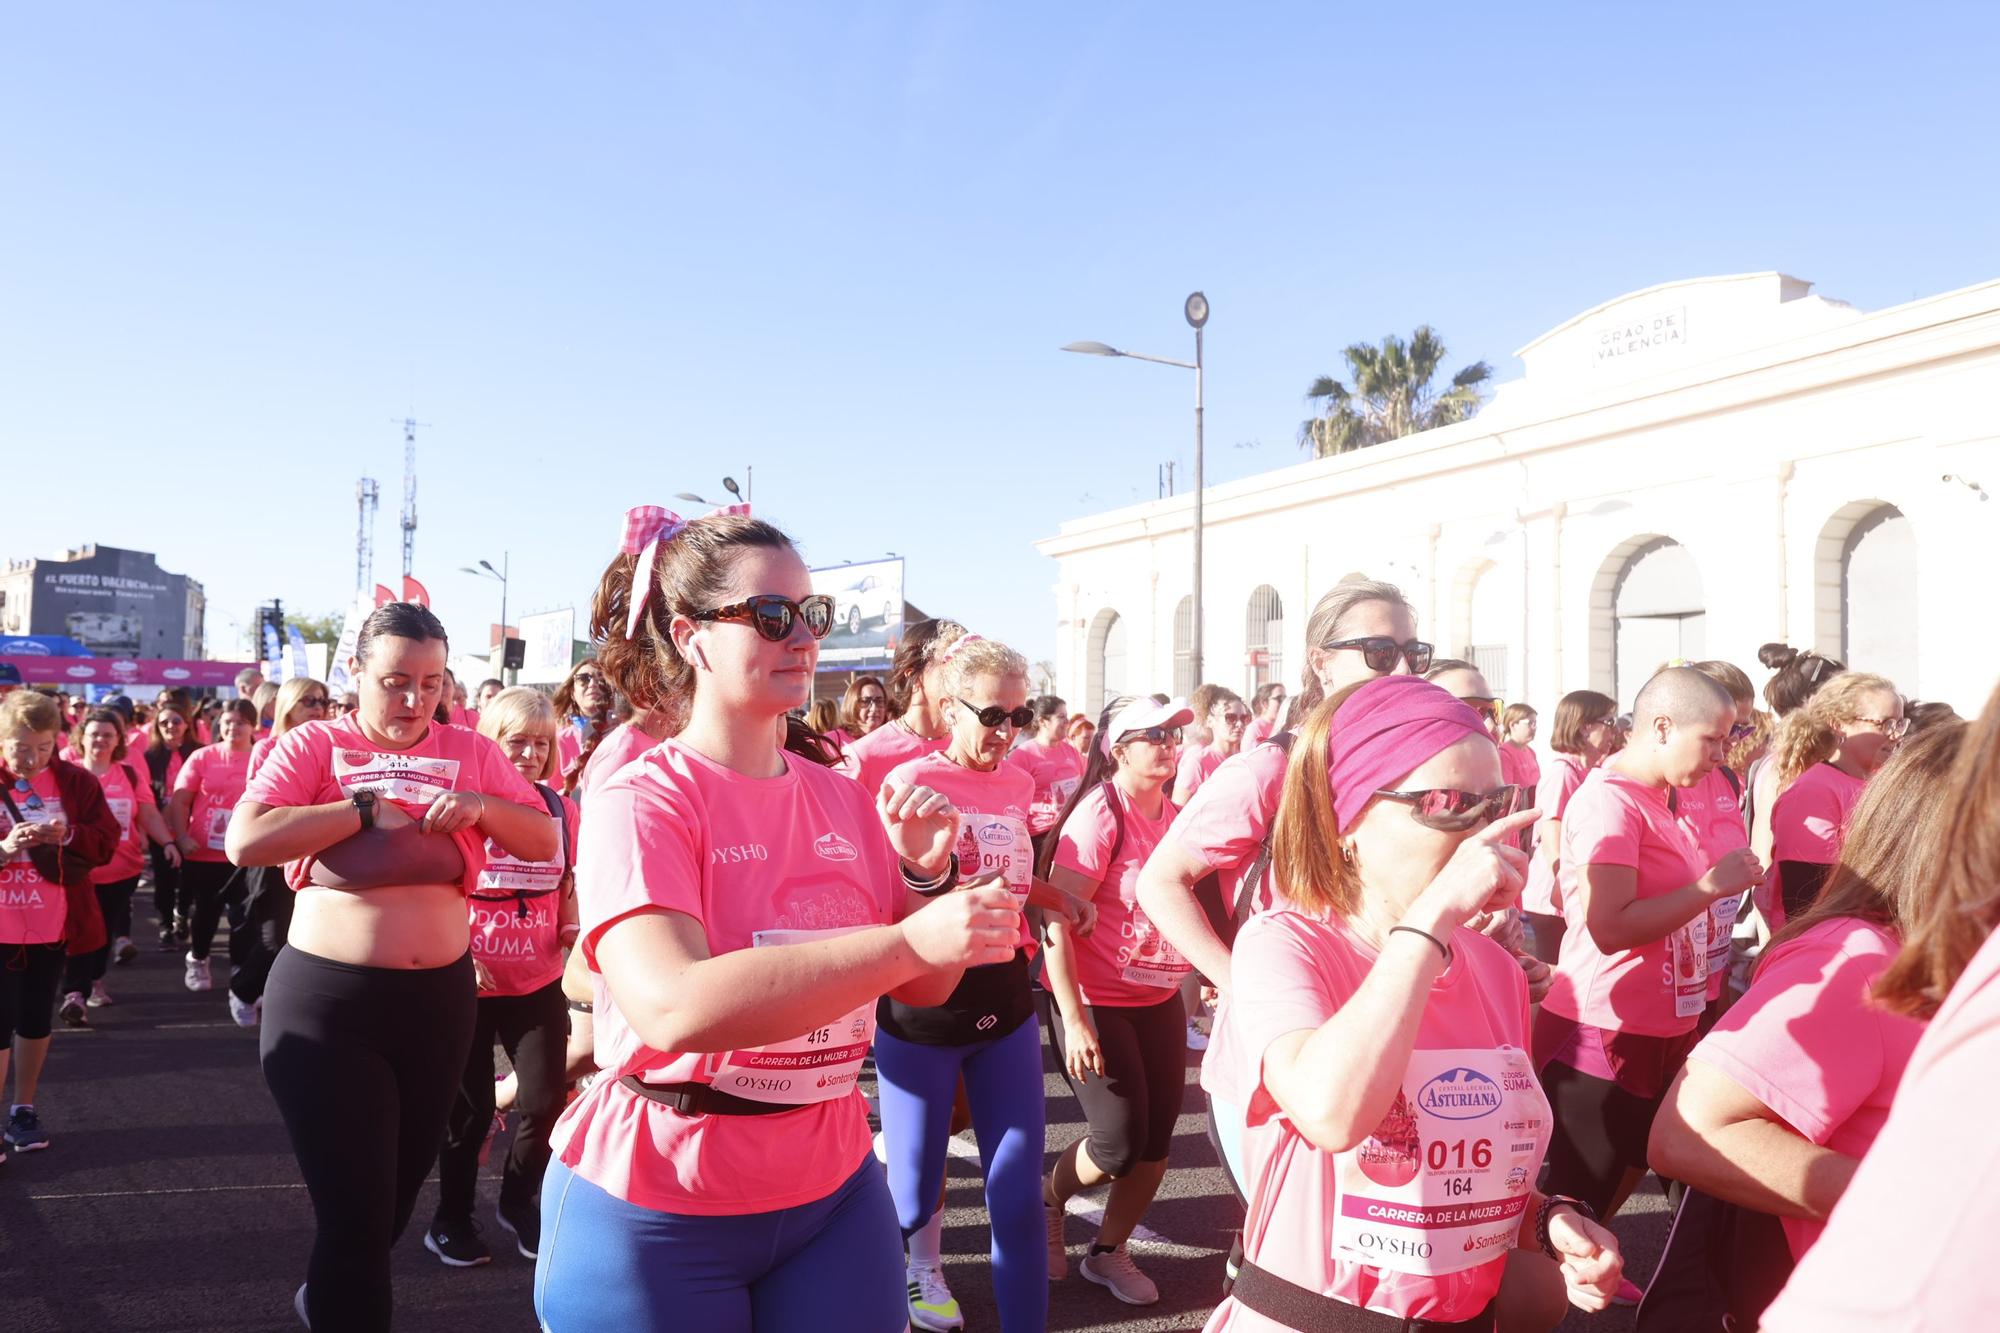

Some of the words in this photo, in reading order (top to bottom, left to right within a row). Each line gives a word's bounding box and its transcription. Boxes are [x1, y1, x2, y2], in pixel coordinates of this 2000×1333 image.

[1600, 324, 1644, 345] GRAO
[1653, 314, 1676, 330] DE
[1598, 329, 1680, 360] VALENCIA
[58, 574, 100, 587] PUERTO
[351, 772, 385, 783] CARRERA
[407, 773, 429, 782] MUJER
[983, 853, 1010, 868] 016
[476, 908, 550, 930] DORSAL
[1716, 922, 1734, 937] 016
[470, 933, 535, 955] SUMA
[807, 1028, 830, 1045] 415
[750, 1056, 798, 1066] CARRERA
[798, 1055, 811, 1066] DE
[812, 1054, 822, 1064] LA
[823, 1050, 849, 1063] MUJER
[849, 1046, 865, 1058] 2023
[735, 1074, 792, 1092] OYSHO
[826, 1070, 859, 1087] Santande
[1503, 1079, 1534, 1092] SUMA
[1425, 1087, 1497, 1108] ASTURIANA
[1427, 1138, 1493, 1171] 016
[1443, 1177, 1473, 1197] 164
[1367, 1205, 1434, 1224] CARRERA
[1436, 1211, 1452, 1224] DE
[1453, 1210, 1468, 1222] LA
[1468, 1205, 1503, 1221] MUJER
[1358, 1232, 1434, 1260] OYSHO
